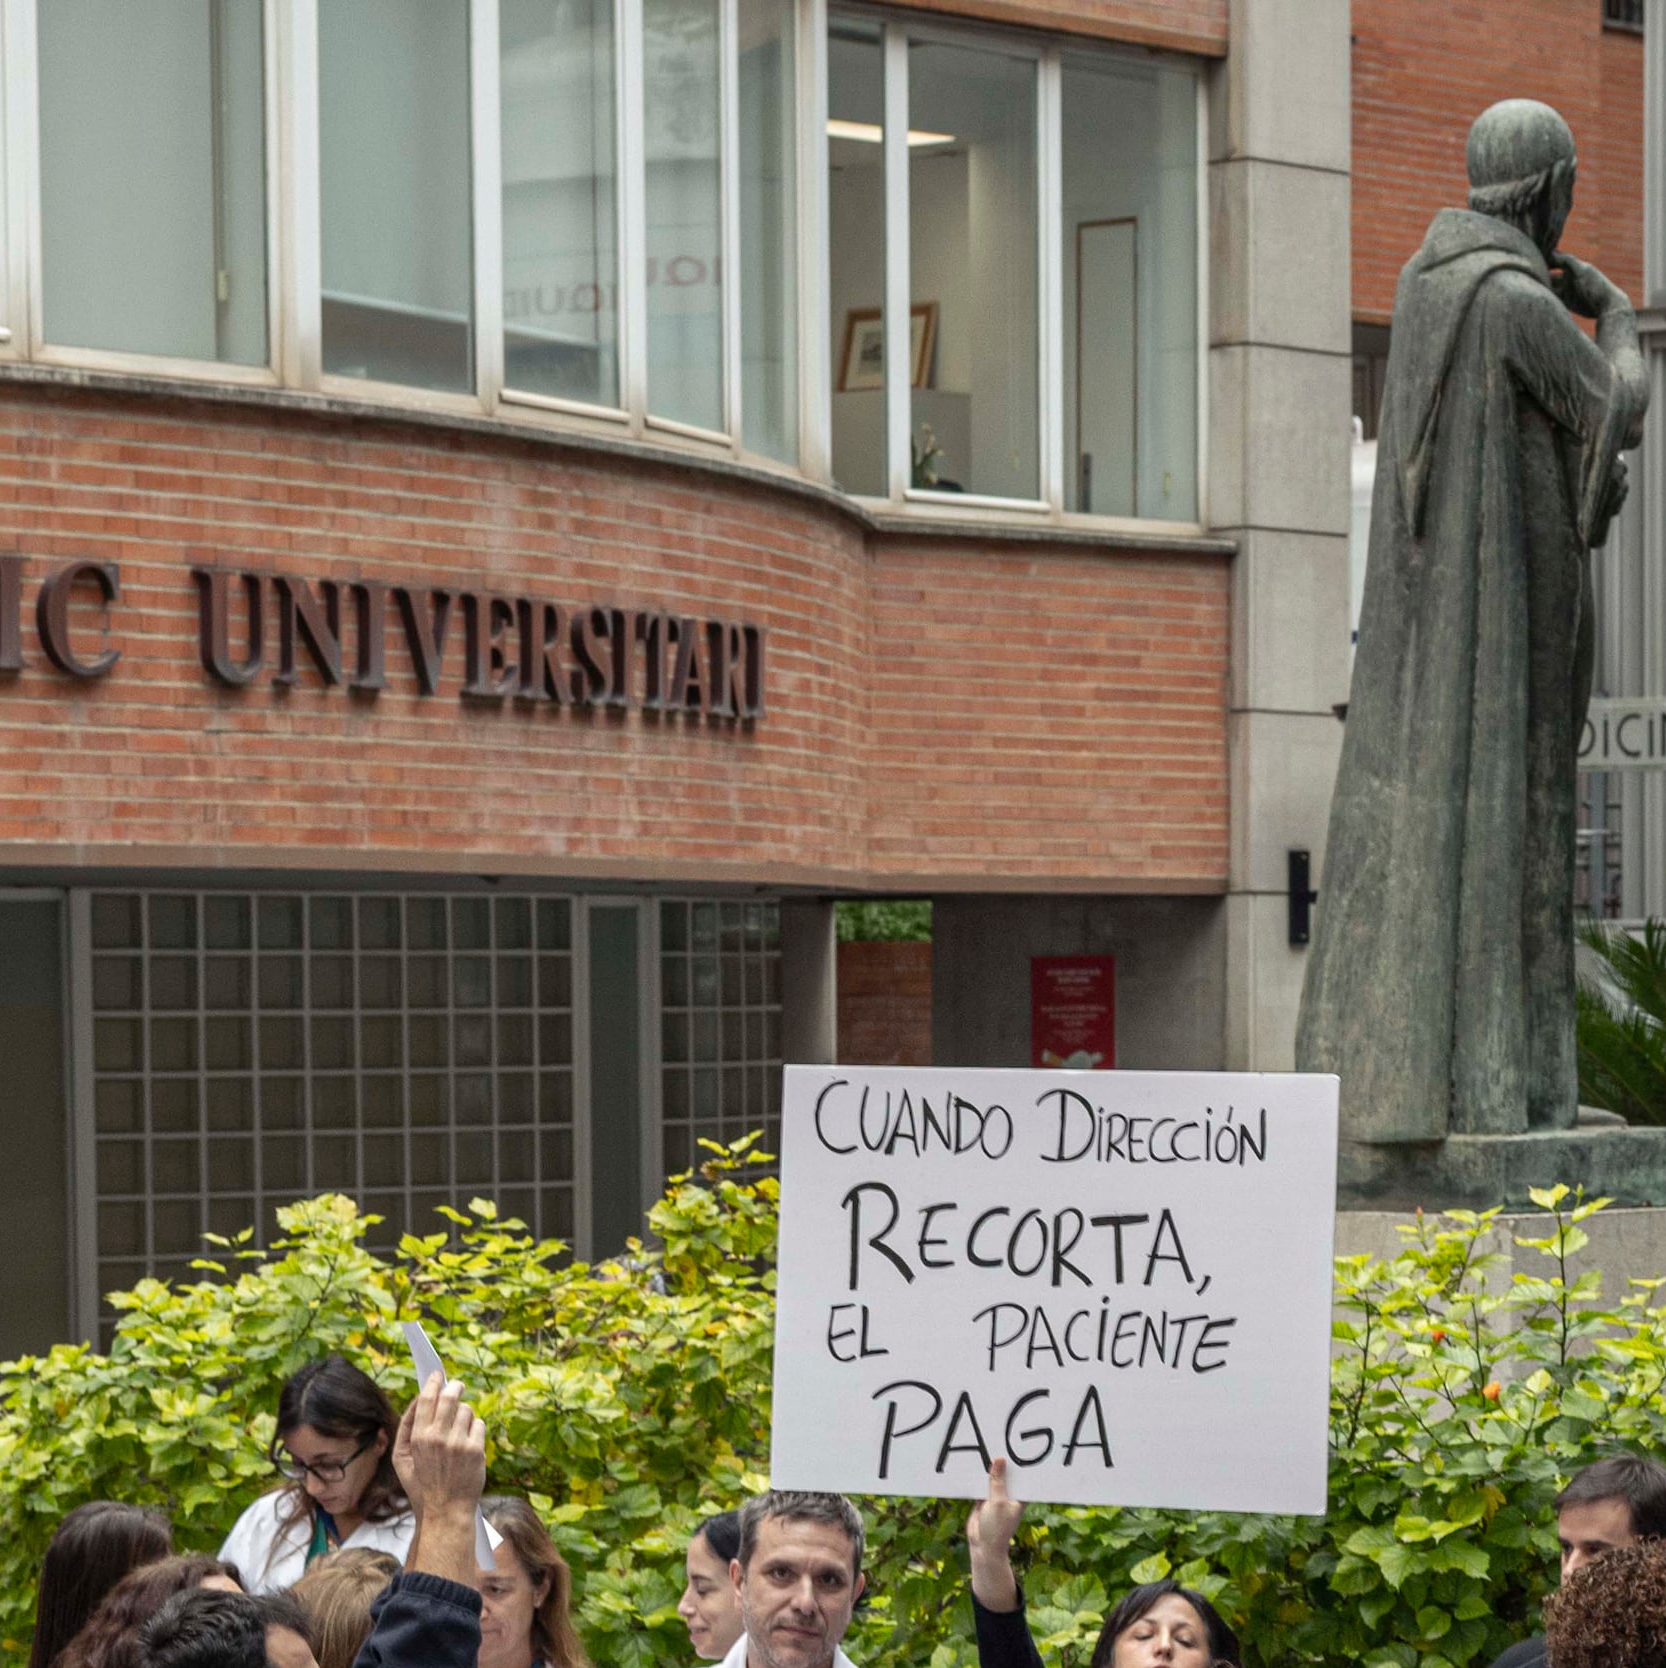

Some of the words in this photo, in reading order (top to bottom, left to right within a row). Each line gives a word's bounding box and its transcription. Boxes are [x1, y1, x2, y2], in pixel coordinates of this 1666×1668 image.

[189, 562, 767, 724] UNIVERSITARI
[815, 1080, 1013, 1160] CUANDO
[841, 1181, 1212, 1295] RECORTA,
[827, 1304, 890, 1362] EL
[872, 1380, 1114, 1479] PAGA
